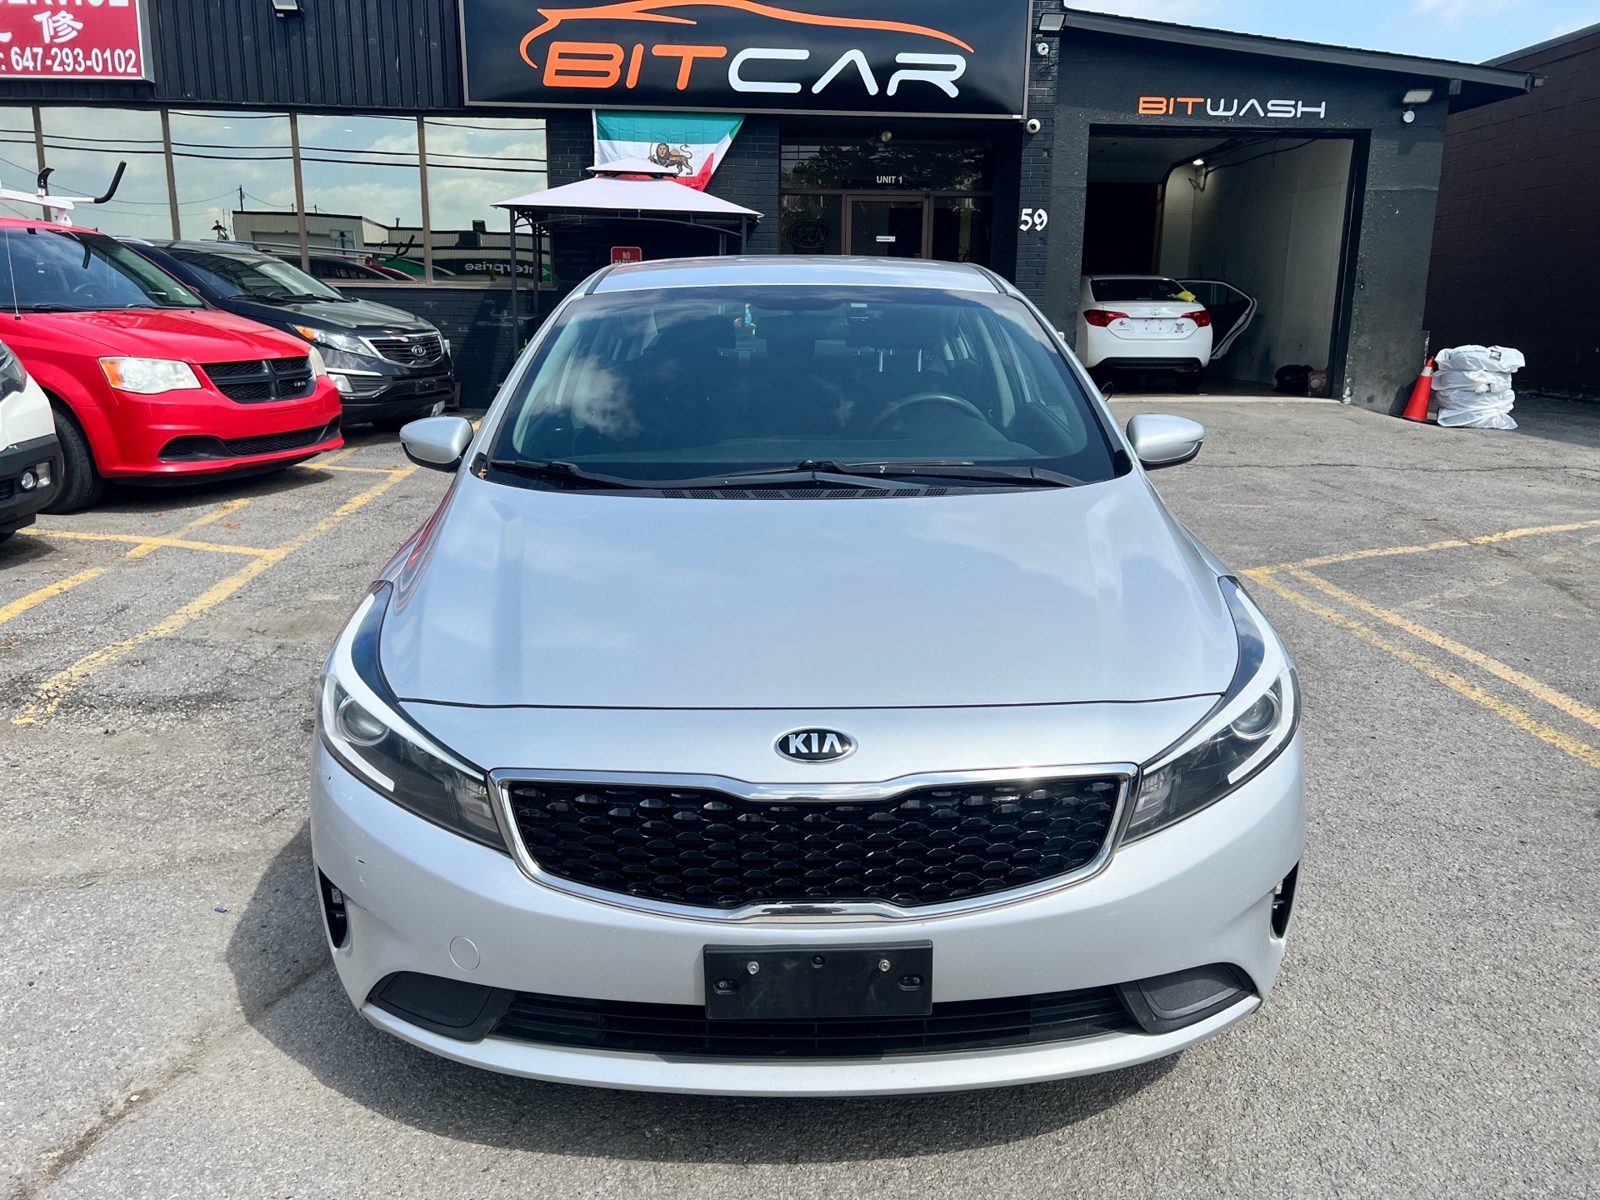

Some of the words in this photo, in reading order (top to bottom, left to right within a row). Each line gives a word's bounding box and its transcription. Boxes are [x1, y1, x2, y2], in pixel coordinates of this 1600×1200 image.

[10, 46, 138, 74] 647-293-0102
[542, 41, 967, 98] BITCAR
[1138, 96, 1326, 119] BITWASH
[876, 176, 898, 184] UNIT
[1019, 208, 1049, 231] 59
[788, 733, 843, 754] KIA
